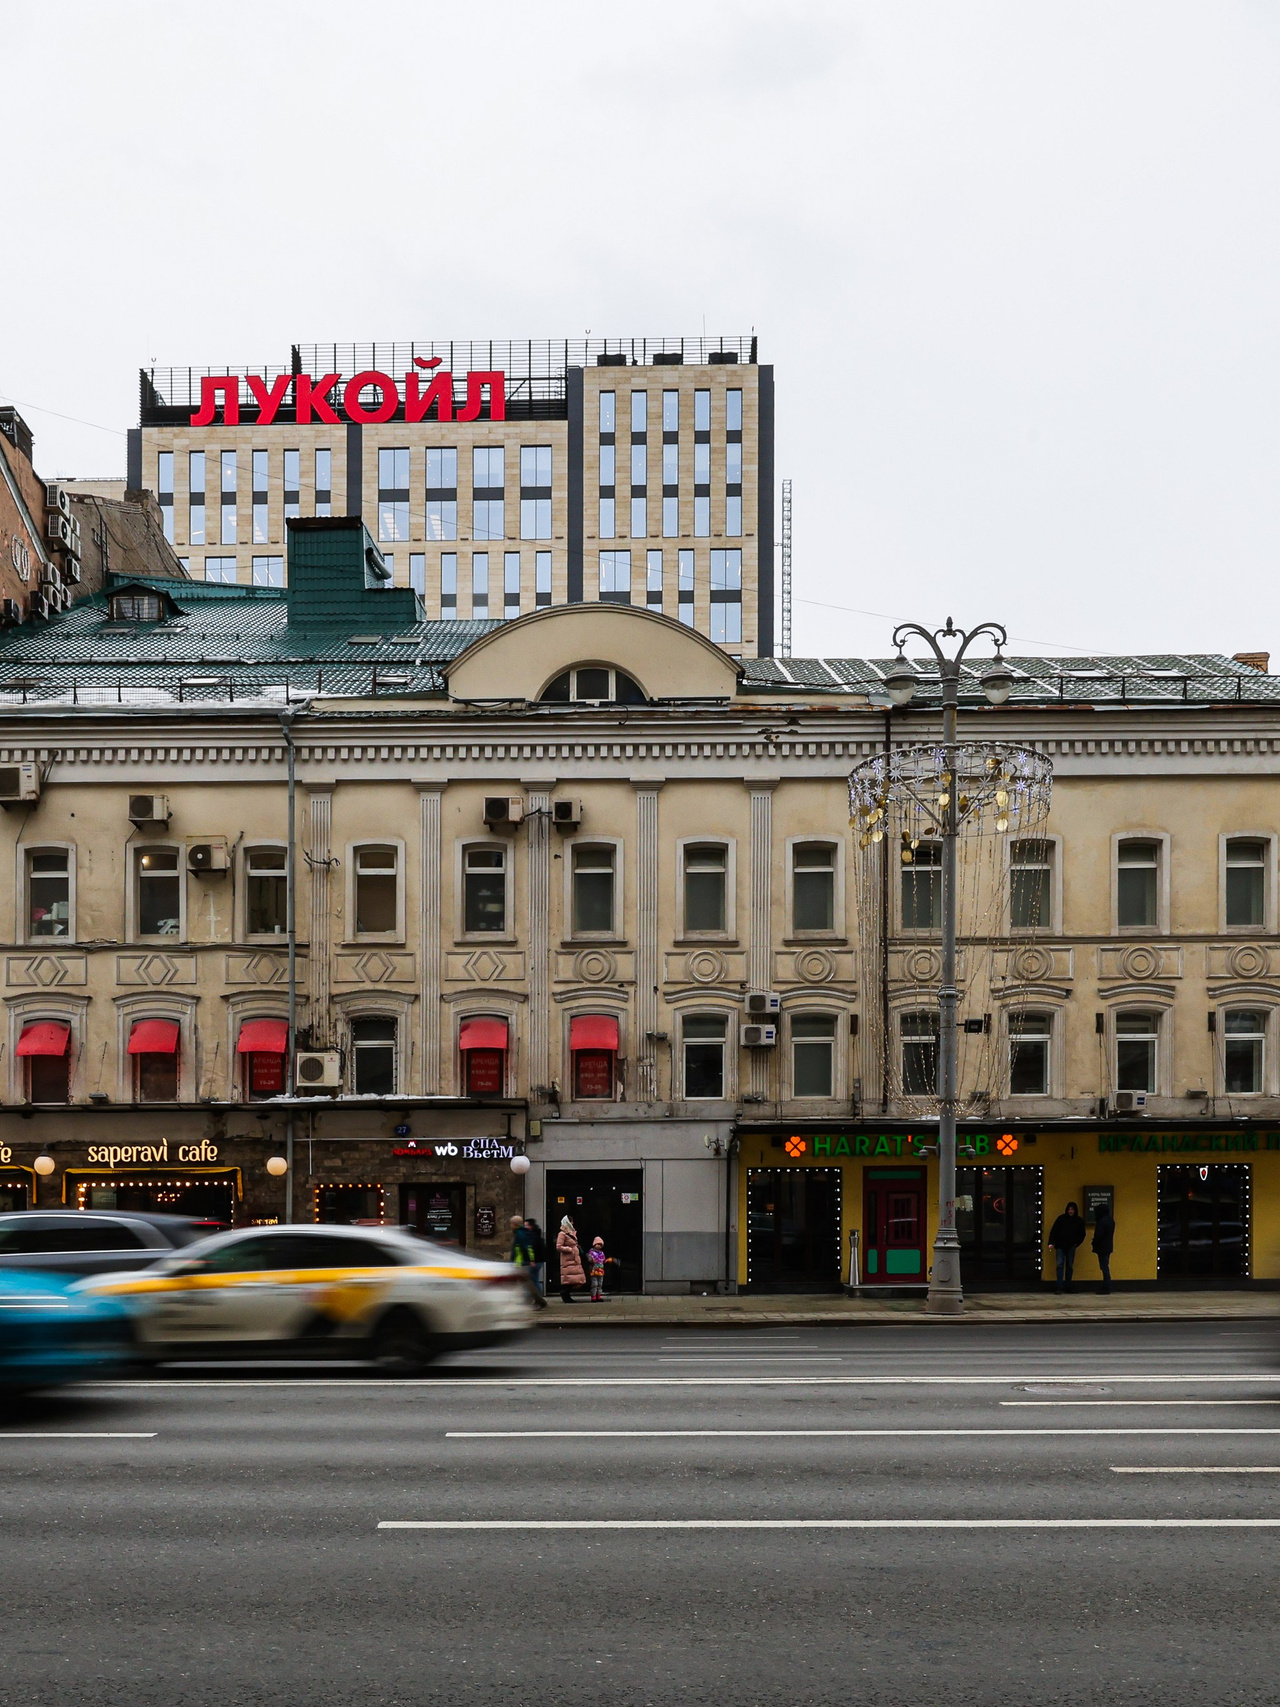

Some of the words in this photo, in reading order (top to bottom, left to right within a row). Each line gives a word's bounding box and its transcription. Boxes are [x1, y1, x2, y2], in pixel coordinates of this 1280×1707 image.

[190, 356, 506, 426] ЛУКОЙЛ
[397, 1126, 407, 1134] 27
[1099, 1130, 1258, 1152] ИРЛАНДСКИЙ
[87, 1137, 168, 1169] saperavi
[178, 1138, 218, 1162] cafe
[435, 1142, 458, 1157] wb
[470, 1138, 499, 1149] СПА
[814, 1135, 926, 1157] HARAT'S
